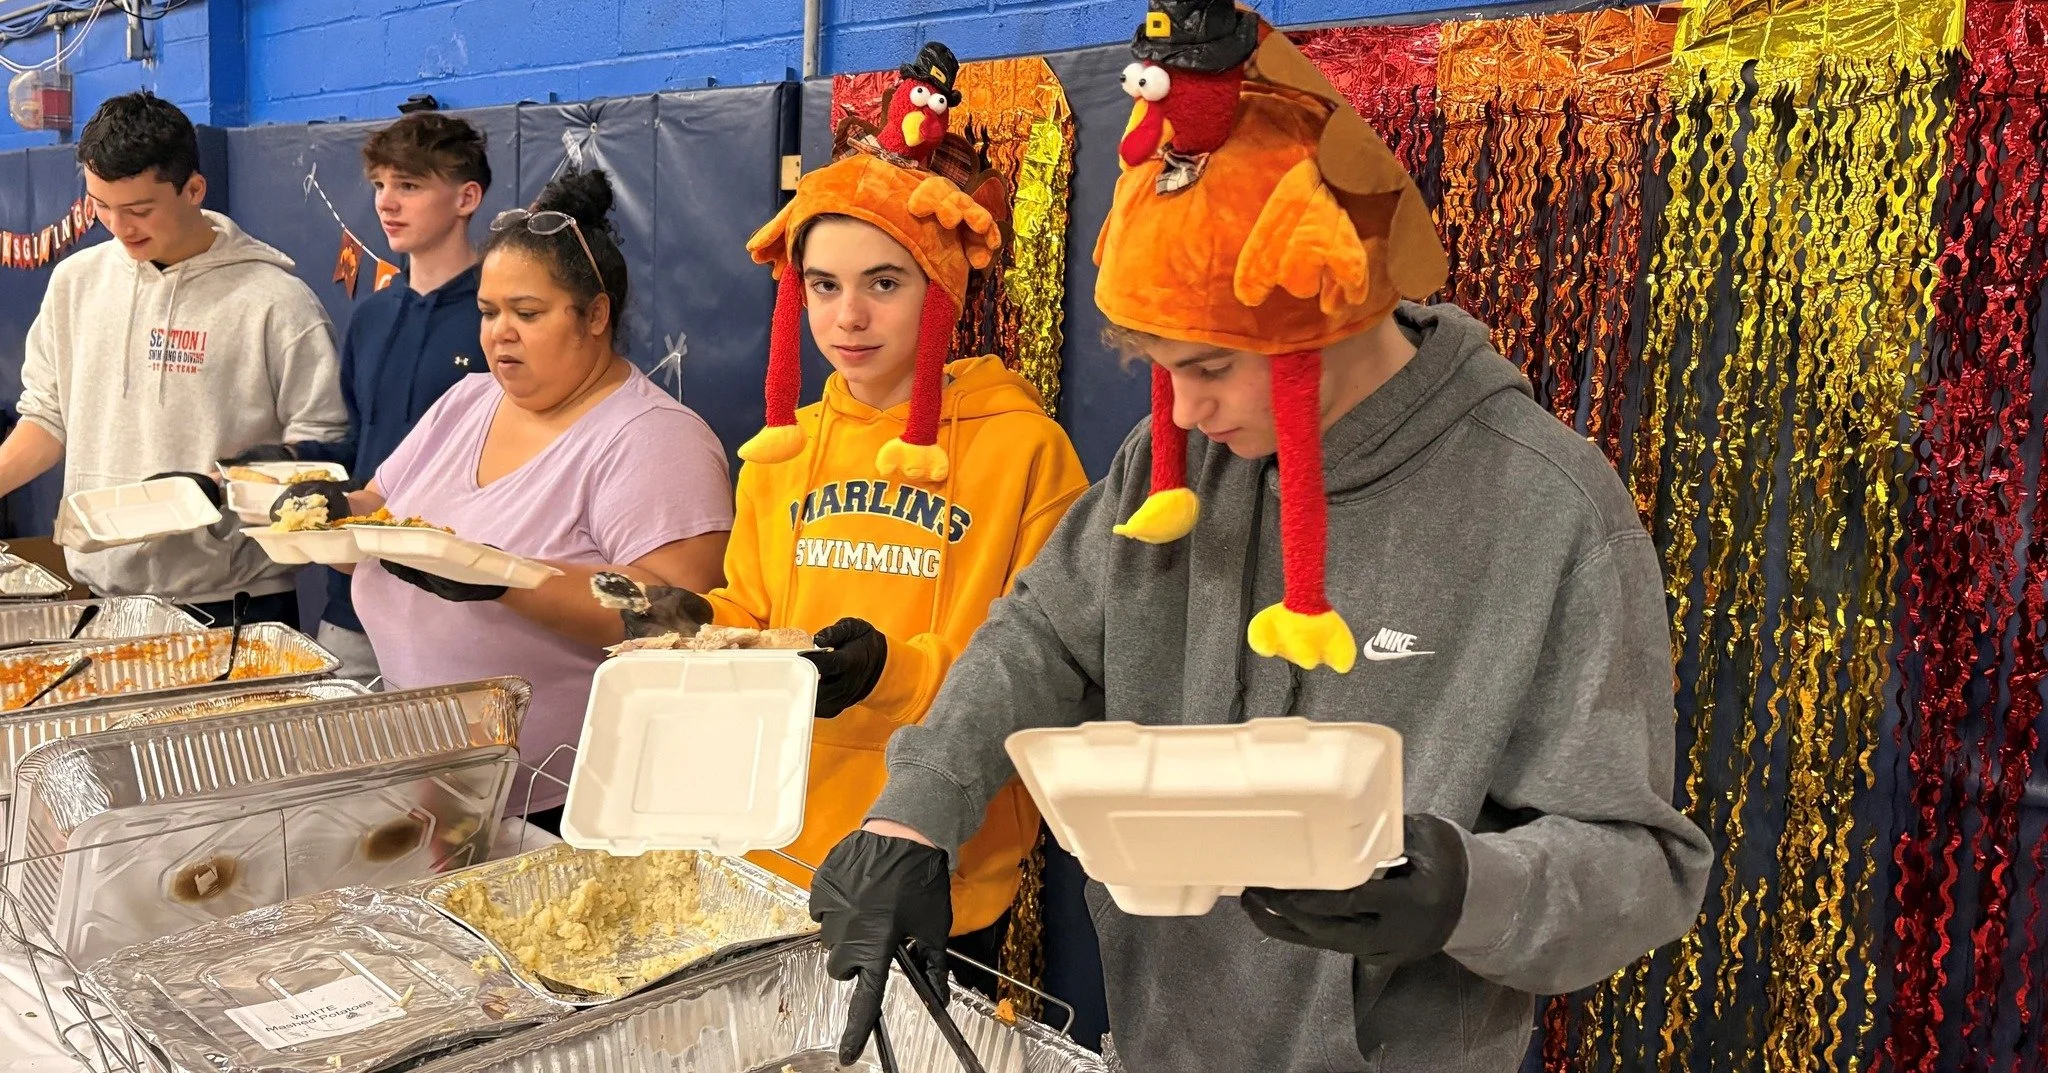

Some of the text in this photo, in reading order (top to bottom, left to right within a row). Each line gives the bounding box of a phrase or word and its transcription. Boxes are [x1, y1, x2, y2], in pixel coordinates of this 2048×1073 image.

[183, 351, 205, 364] DIVING
[789, 478, 973, 545] MARLINS
[795, 538, 941, 579] SWIMMING
[1373, 627, 1418, 652] NIKE
[265, 1000, 374, 1033] Mashed Potatoes
[290, 1004, 337, 1020] WHITE
